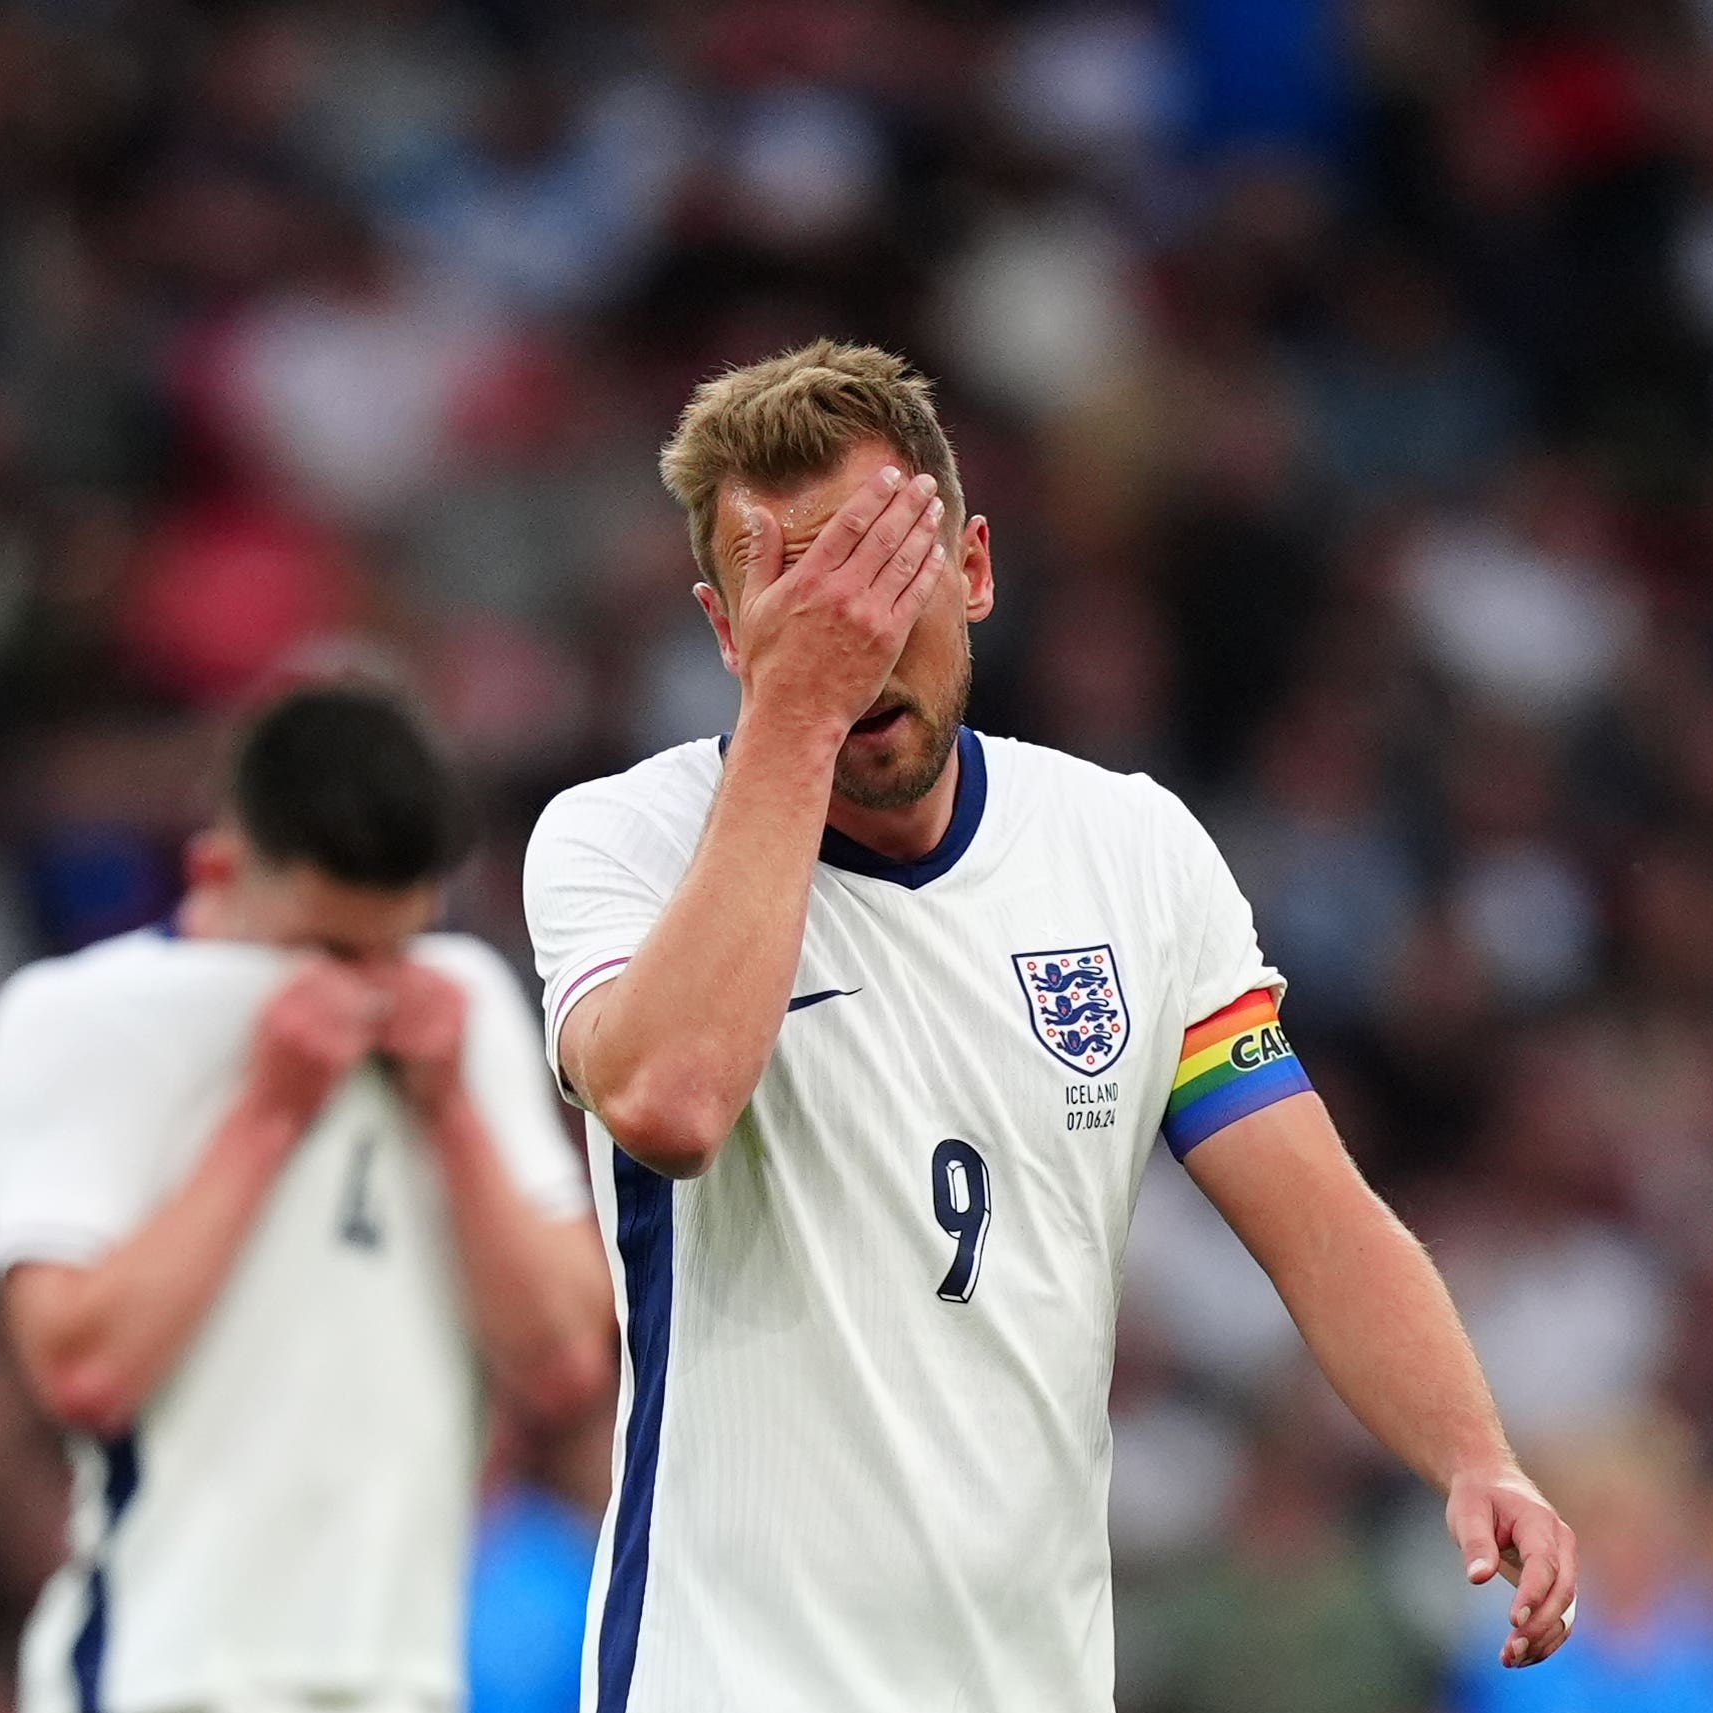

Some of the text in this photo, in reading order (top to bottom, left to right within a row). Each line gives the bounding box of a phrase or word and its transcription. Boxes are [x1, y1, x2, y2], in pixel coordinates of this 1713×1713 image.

[1065, 1082, 1119, 1105] ICELAND
[1066, 1108, 1116, 1131] 07.06.24
[931, 1138, 991, 1304] 9
